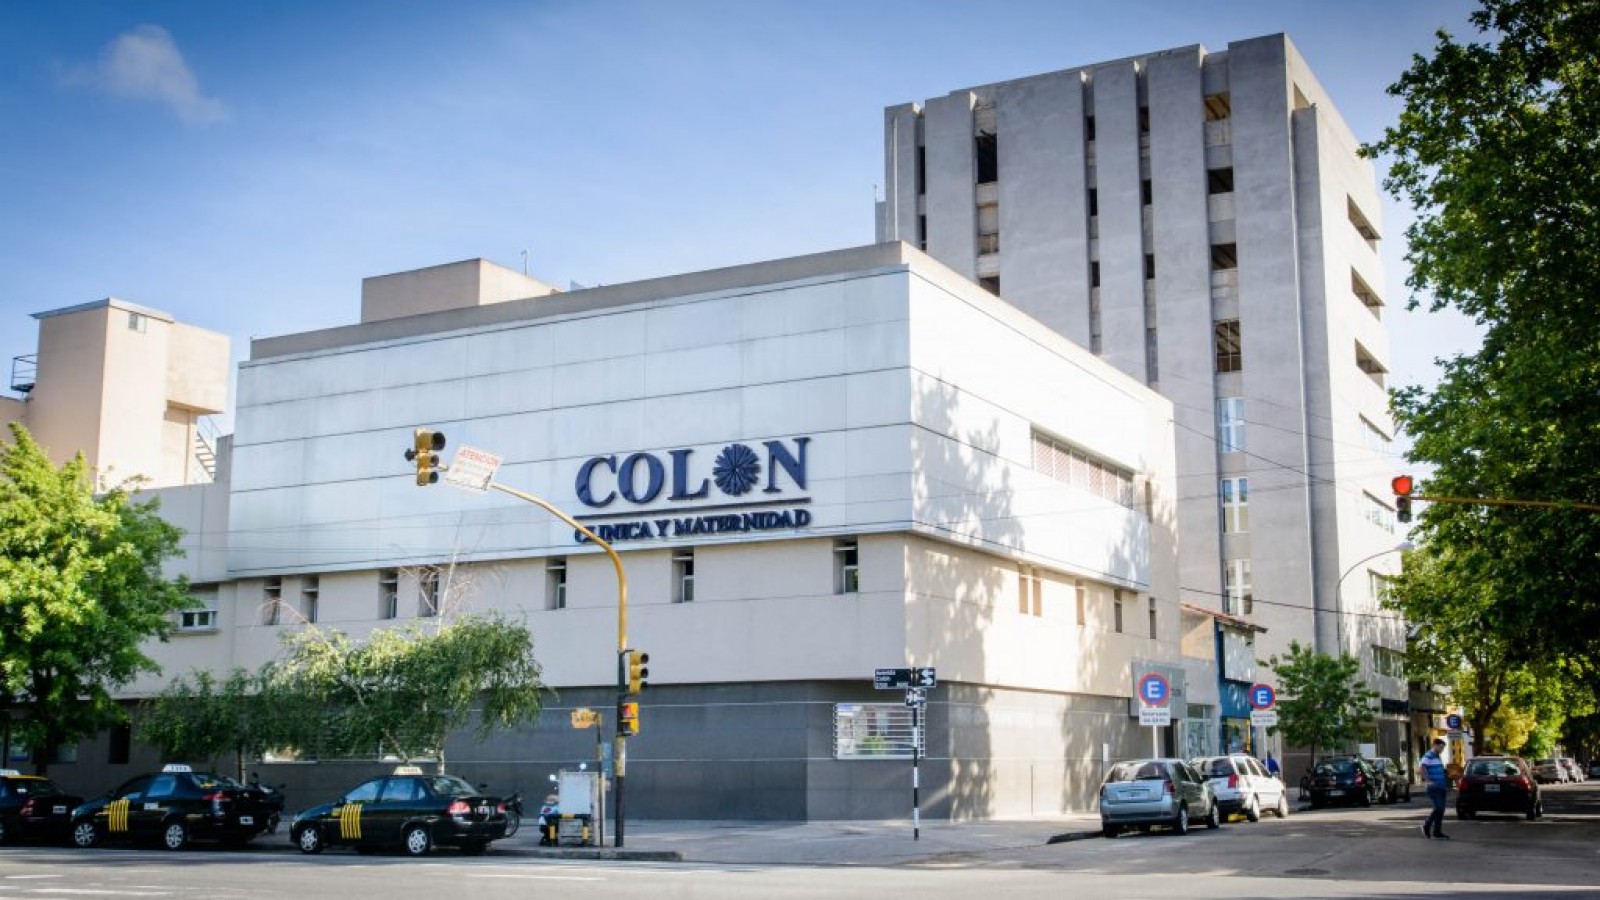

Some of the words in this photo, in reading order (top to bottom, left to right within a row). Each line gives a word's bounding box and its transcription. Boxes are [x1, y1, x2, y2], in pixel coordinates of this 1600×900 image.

[653, 519, 671, 537] Y
[673, 508, 811, 535] MATERNIDAD
[1147, 681, 1160, 698] E
[1257, 690, 1268, 705] E
